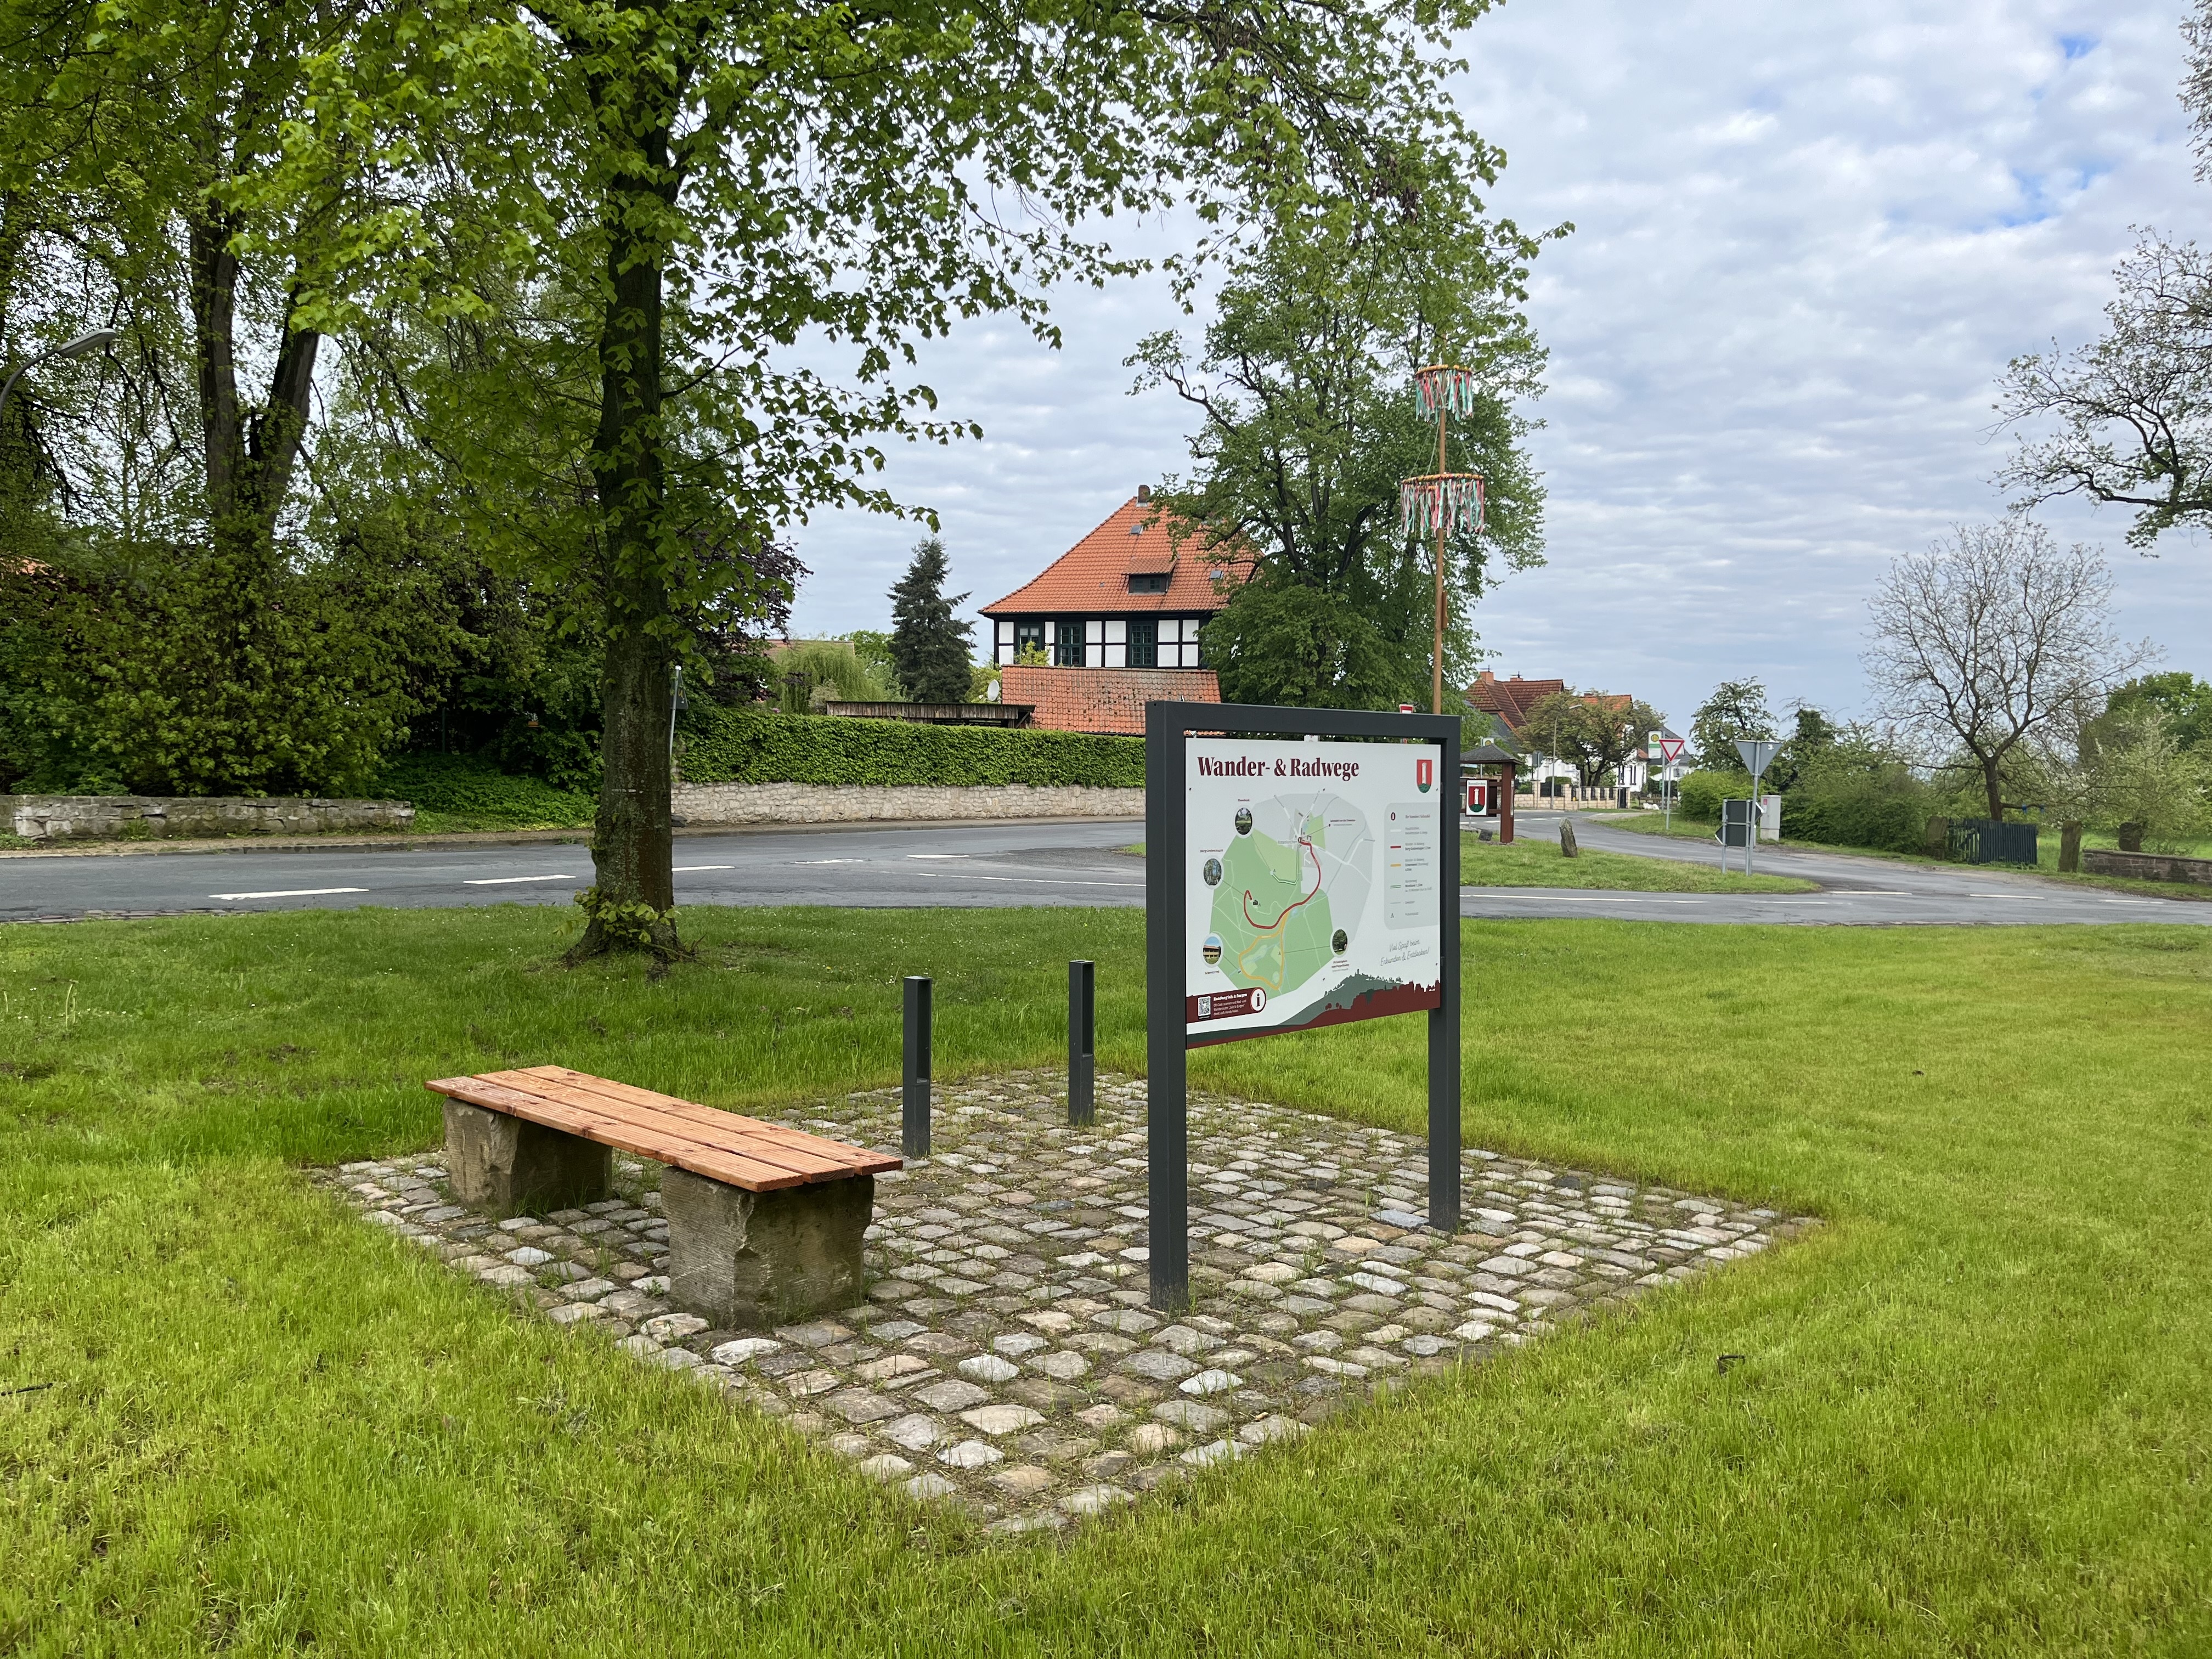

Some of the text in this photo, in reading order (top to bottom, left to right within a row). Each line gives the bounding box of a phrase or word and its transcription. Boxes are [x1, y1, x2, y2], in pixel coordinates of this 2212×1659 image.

[1197, 756, 1359, 781] Wander- & Radwege
